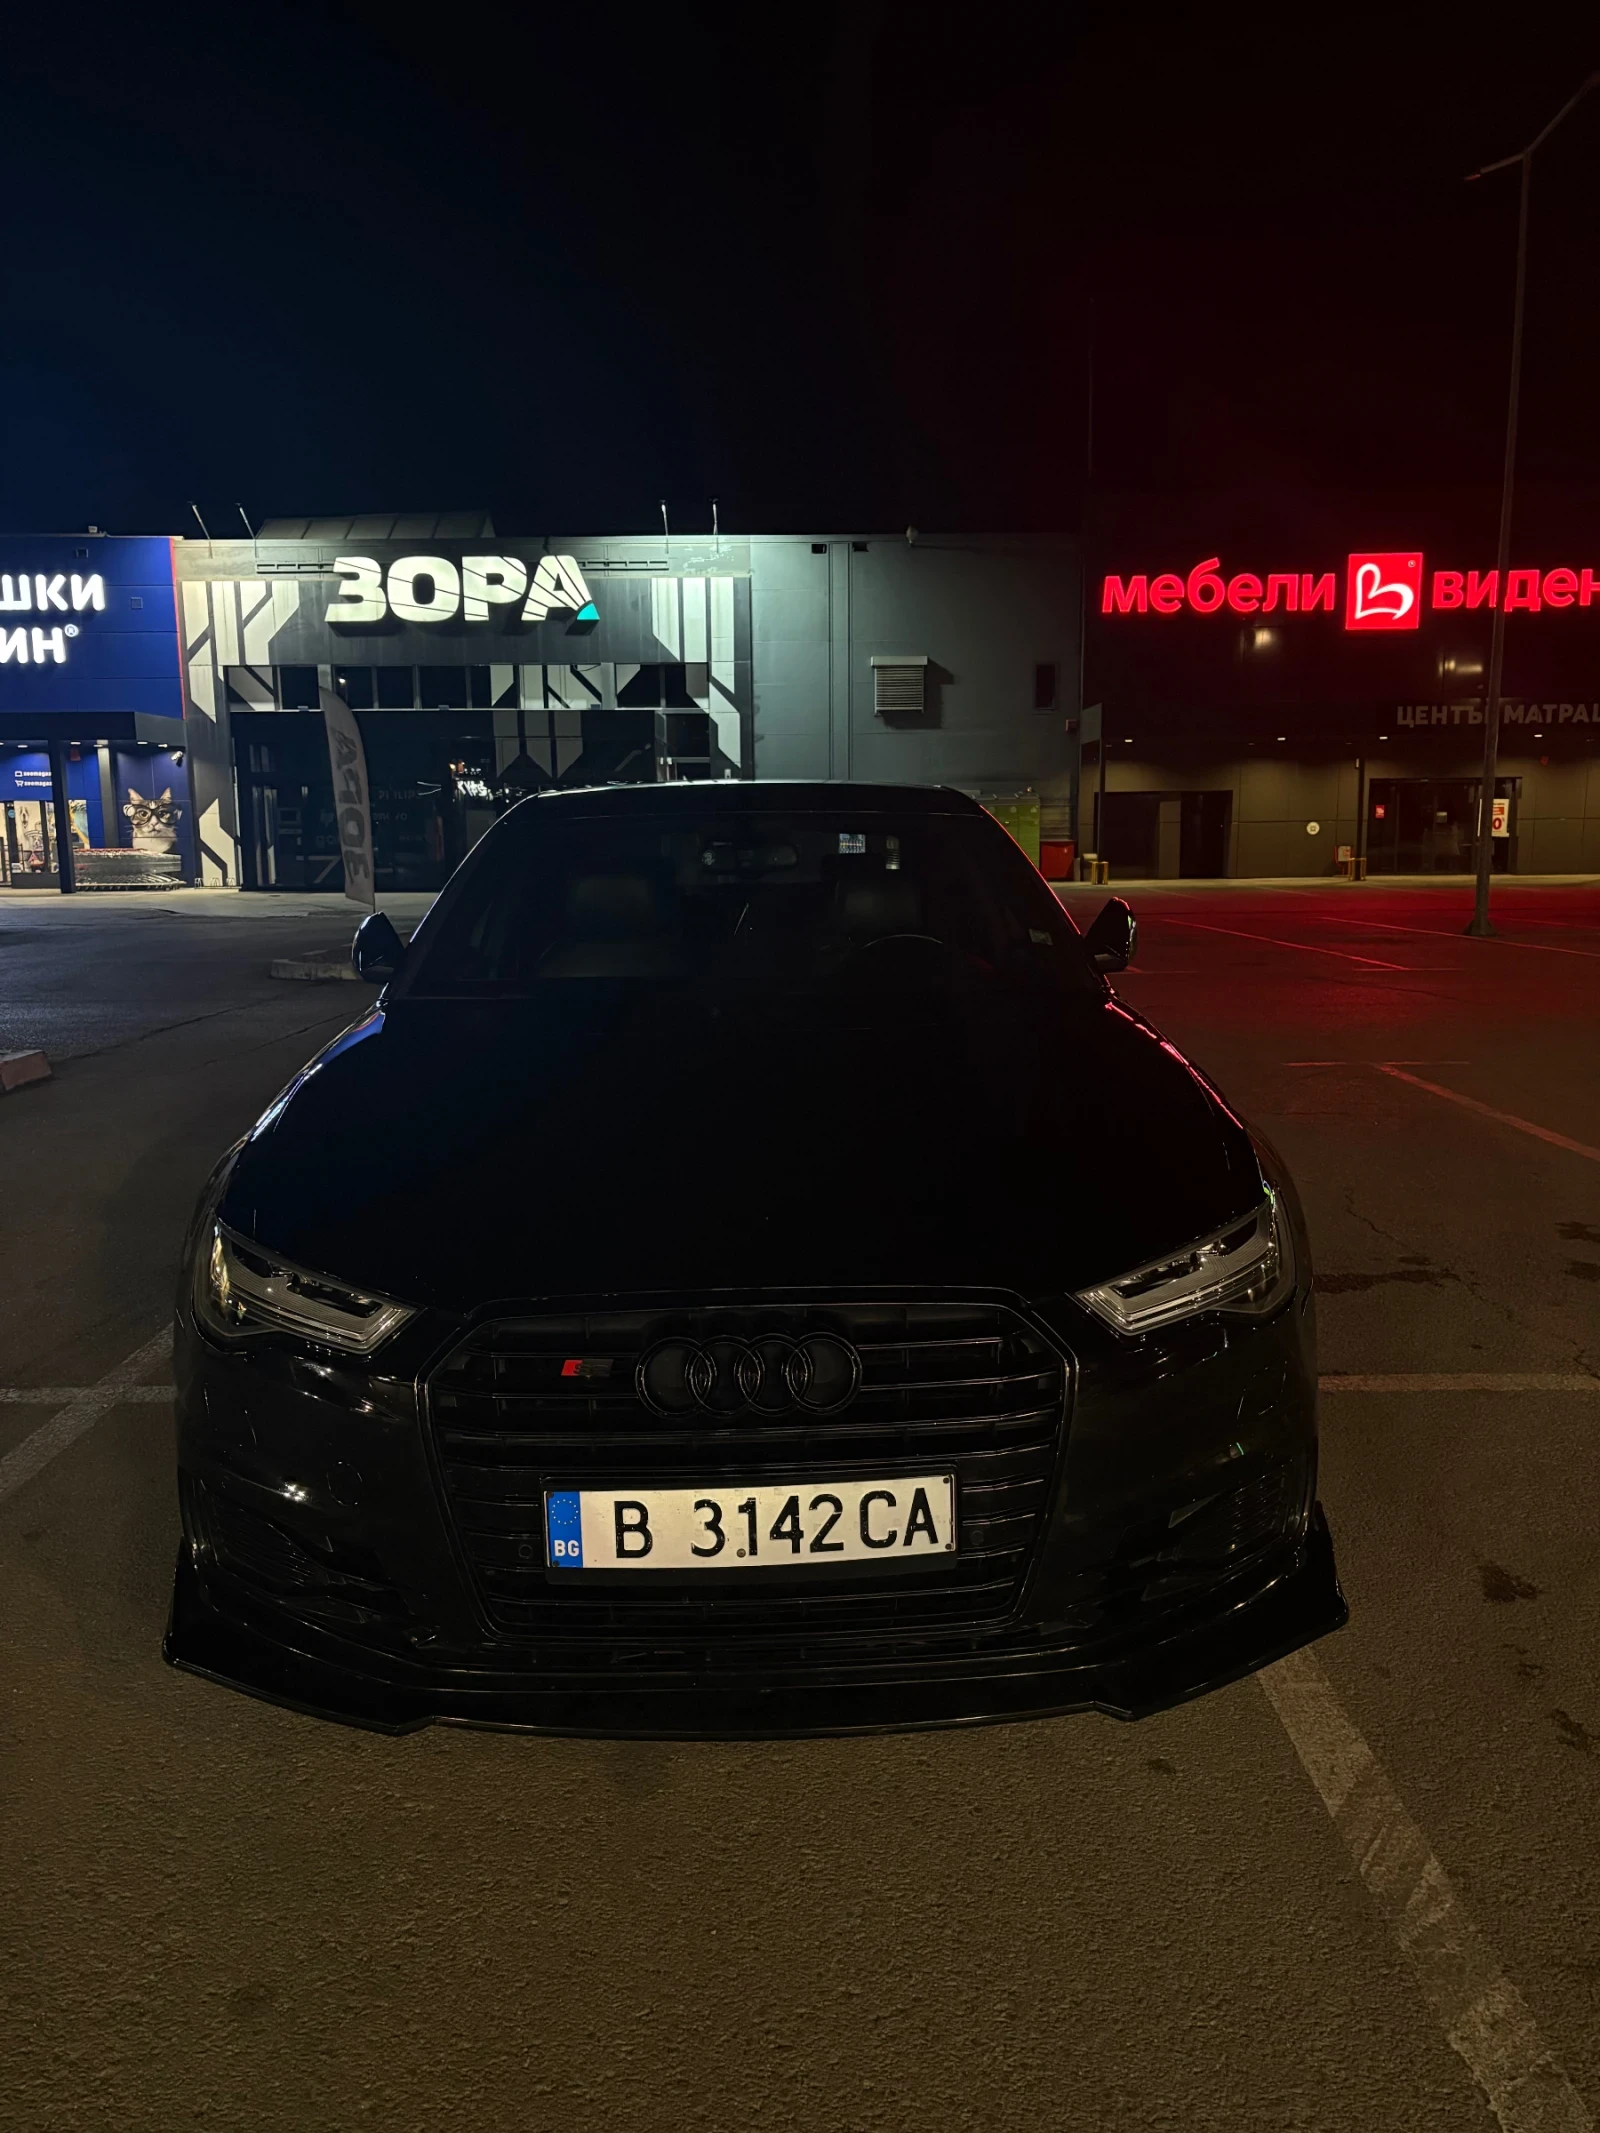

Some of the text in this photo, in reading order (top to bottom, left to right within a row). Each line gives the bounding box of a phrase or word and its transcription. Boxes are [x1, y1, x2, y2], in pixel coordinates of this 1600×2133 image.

[324, 555, 600, 622] ЗОРА
[1102, 557, 1600, 613] мебели виден
[1397, 705, 1489, 728] ЦЕНТЪ
[553, 1539, 580, 1557] BG
[614, 1500, 653, 1558] B
